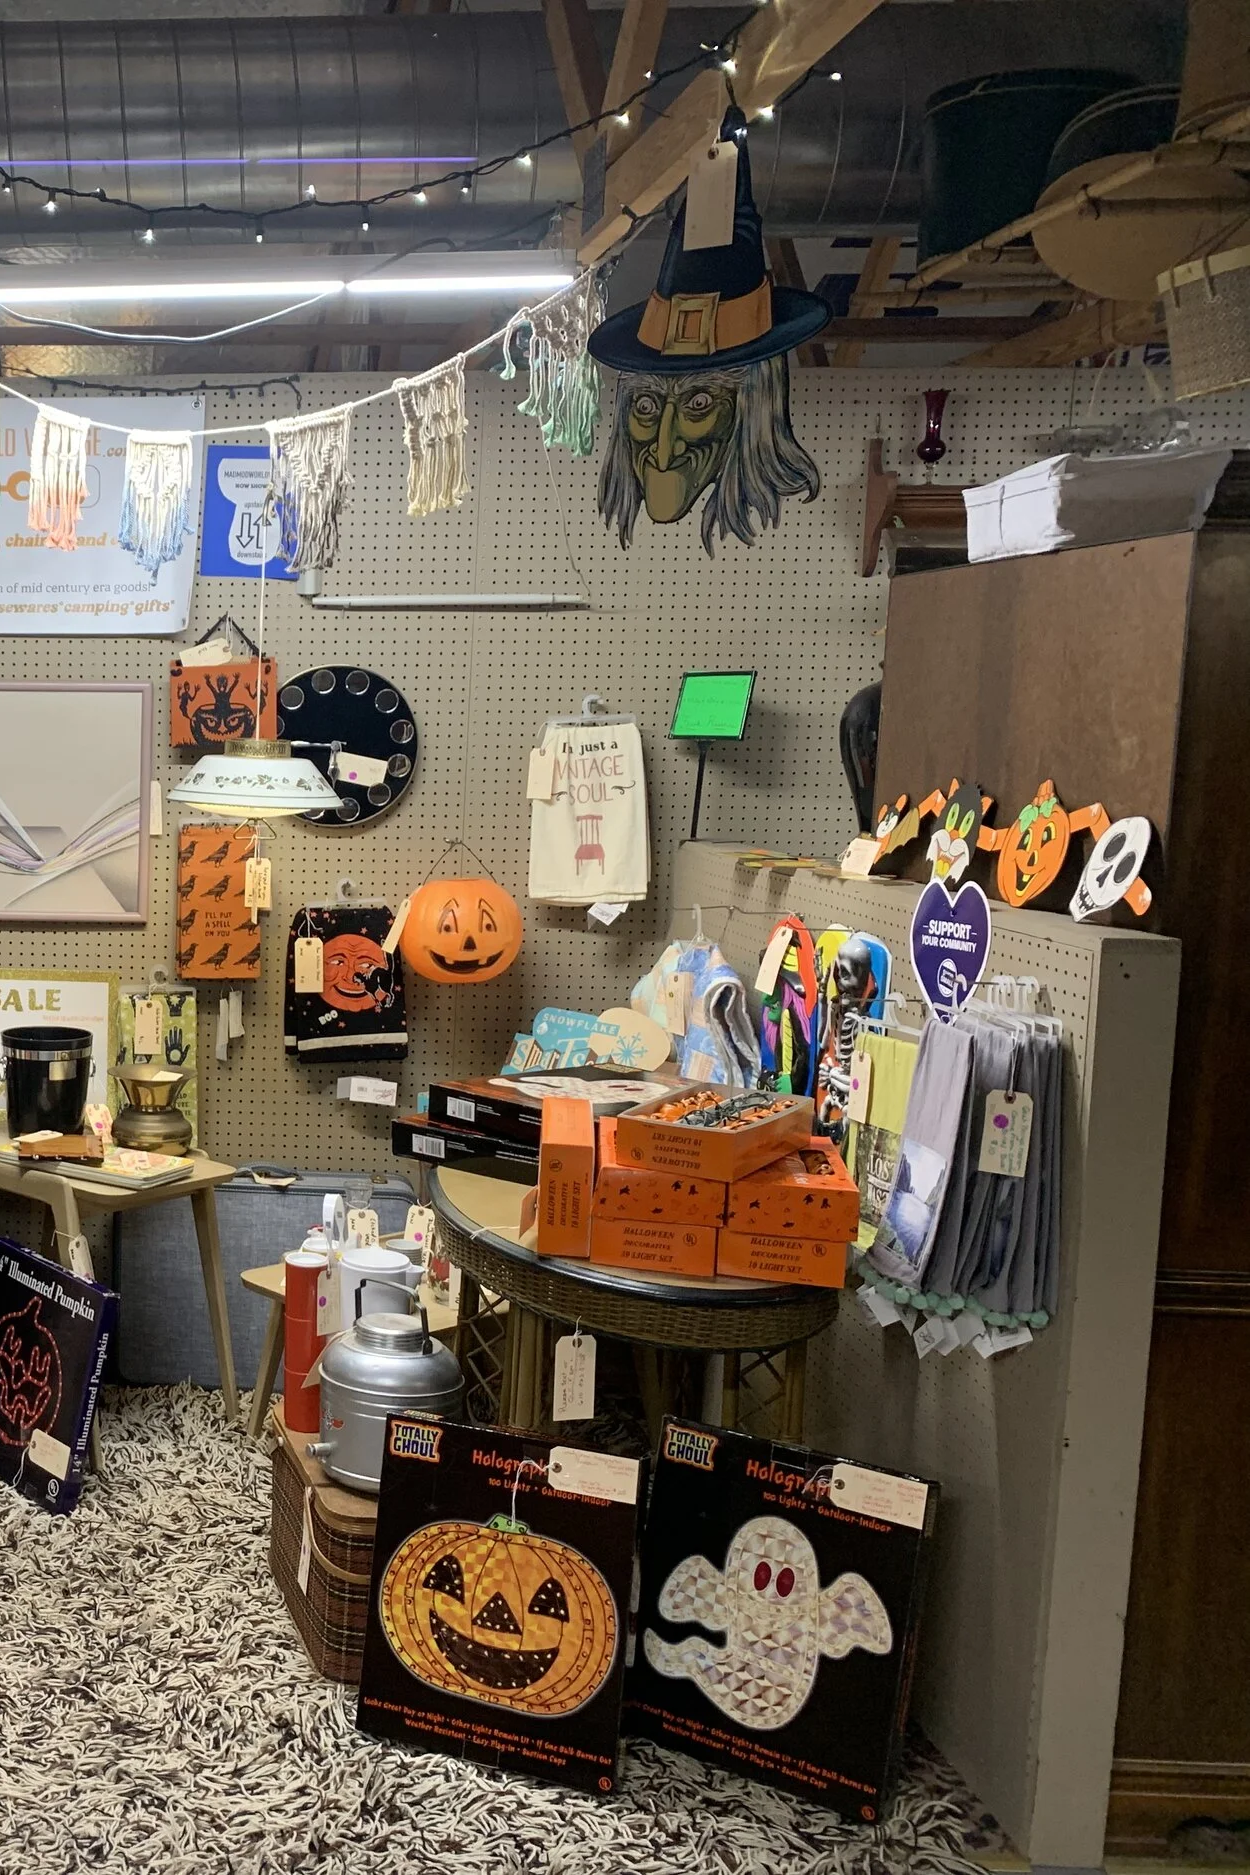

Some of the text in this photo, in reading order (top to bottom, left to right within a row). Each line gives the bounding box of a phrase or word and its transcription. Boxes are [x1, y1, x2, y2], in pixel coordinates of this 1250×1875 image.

[6, 582, 18, 593] of
[21, 582, 43, 593] mid
[45, 583, 89, 595] century
[93, 585, 111, 593] era
[64, 601, 129, 616] camping
[578, 740, 618, 756] just a
[568, 781, 614, 806] SOUL
[212, 920, 230, 928] SPELL
[928, 919, 972, 940] SUPPORT
[922, 934, 977, 953] YOUR COMMUNITY
[318, 1009, 338, 1025] BOO
[542, 1013, 618, 1035] SNOWFLAKE
[623, 1226, 675, 1240] HALLOWEEN
[750, 1237, 805, 1250] HALLOWEEN
[8, 1260, 54, 1300] Illuminated
[54, 1286, 95, 1322] Pumpkin
[76, 1385, 99, 1452] Illuminated
[90, 1332, 110, 1385] Pumpkin
[394, 1423, 440, 1443] TOTALLY
[669, 1428, 714, 1449] TOTALLY
[393, 1436, 437, 1459] GHOUL
[667, 1441, 711, 1467] GHOUL
[472, 1449, 550, 1479] Holograph
[488, 1477, 501, 1487] 100
[779, 1493, 806, 1511] Lights
